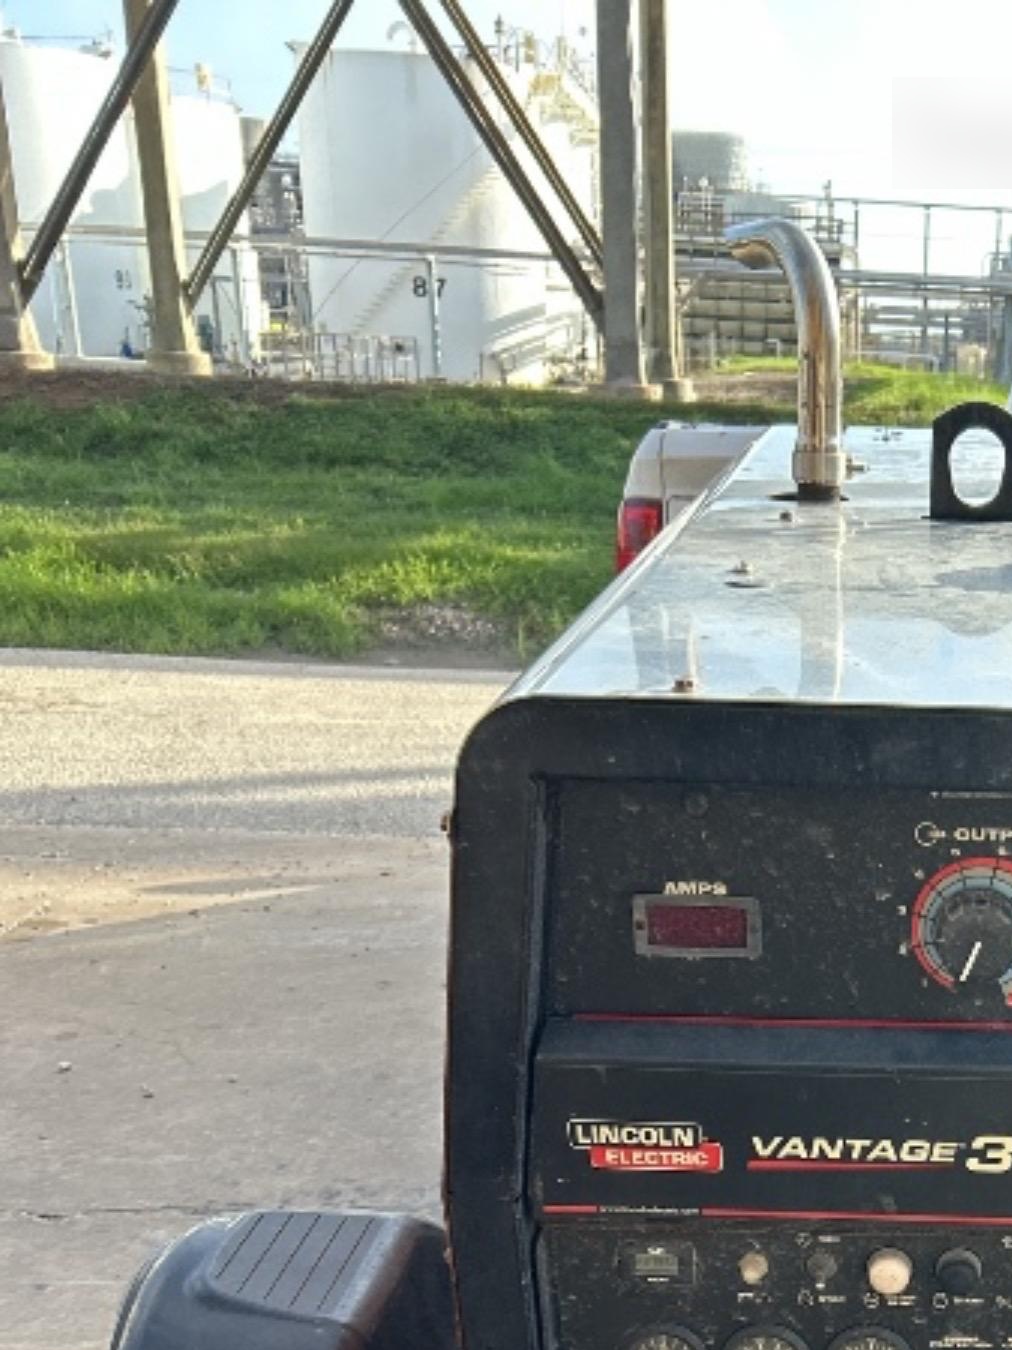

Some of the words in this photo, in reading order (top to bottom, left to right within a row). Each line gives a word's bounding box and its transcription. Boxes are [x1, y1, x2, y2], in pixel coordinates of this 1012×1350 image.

[664, 881, 727, 895] AMPS
[575, 1125, 694, 1146] LINCOLN
[605, 1149, 709, 1167] ELECTRIC
[751, 1136, 959, 1163] VANTAGE
